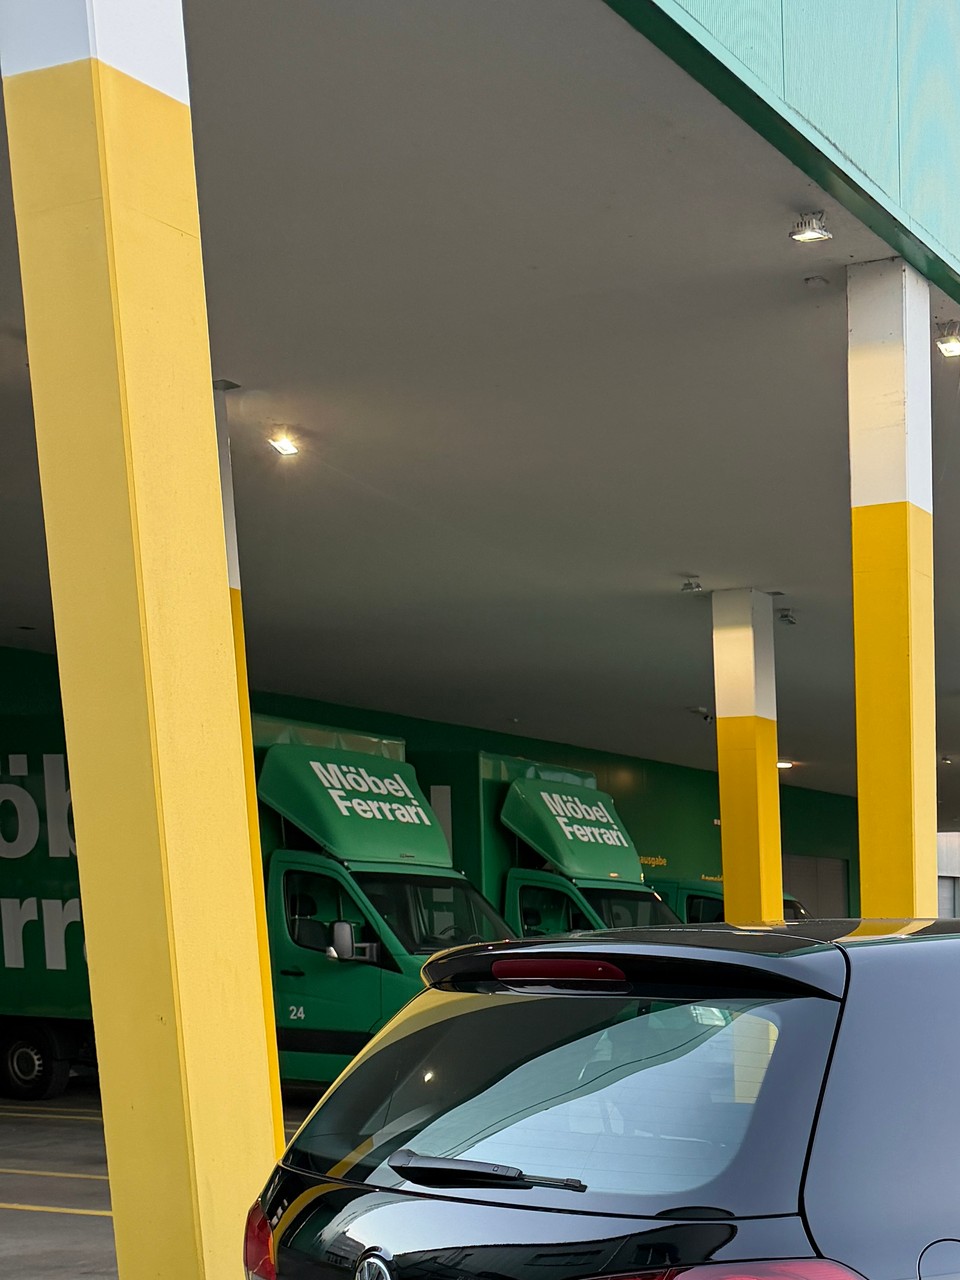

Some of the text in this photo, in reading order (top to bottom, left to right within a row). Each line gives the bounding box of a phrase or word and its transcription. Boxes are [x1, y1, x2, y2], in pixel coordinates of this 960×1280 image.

[309, 761, 414, 798] Möbel
[328, 789, 431, 826] Ferrari
[540, 792, 614, 824] Möbel
[556, 817, 629, 848] Ferrari
[289, 1005, 305, 1020] 24
